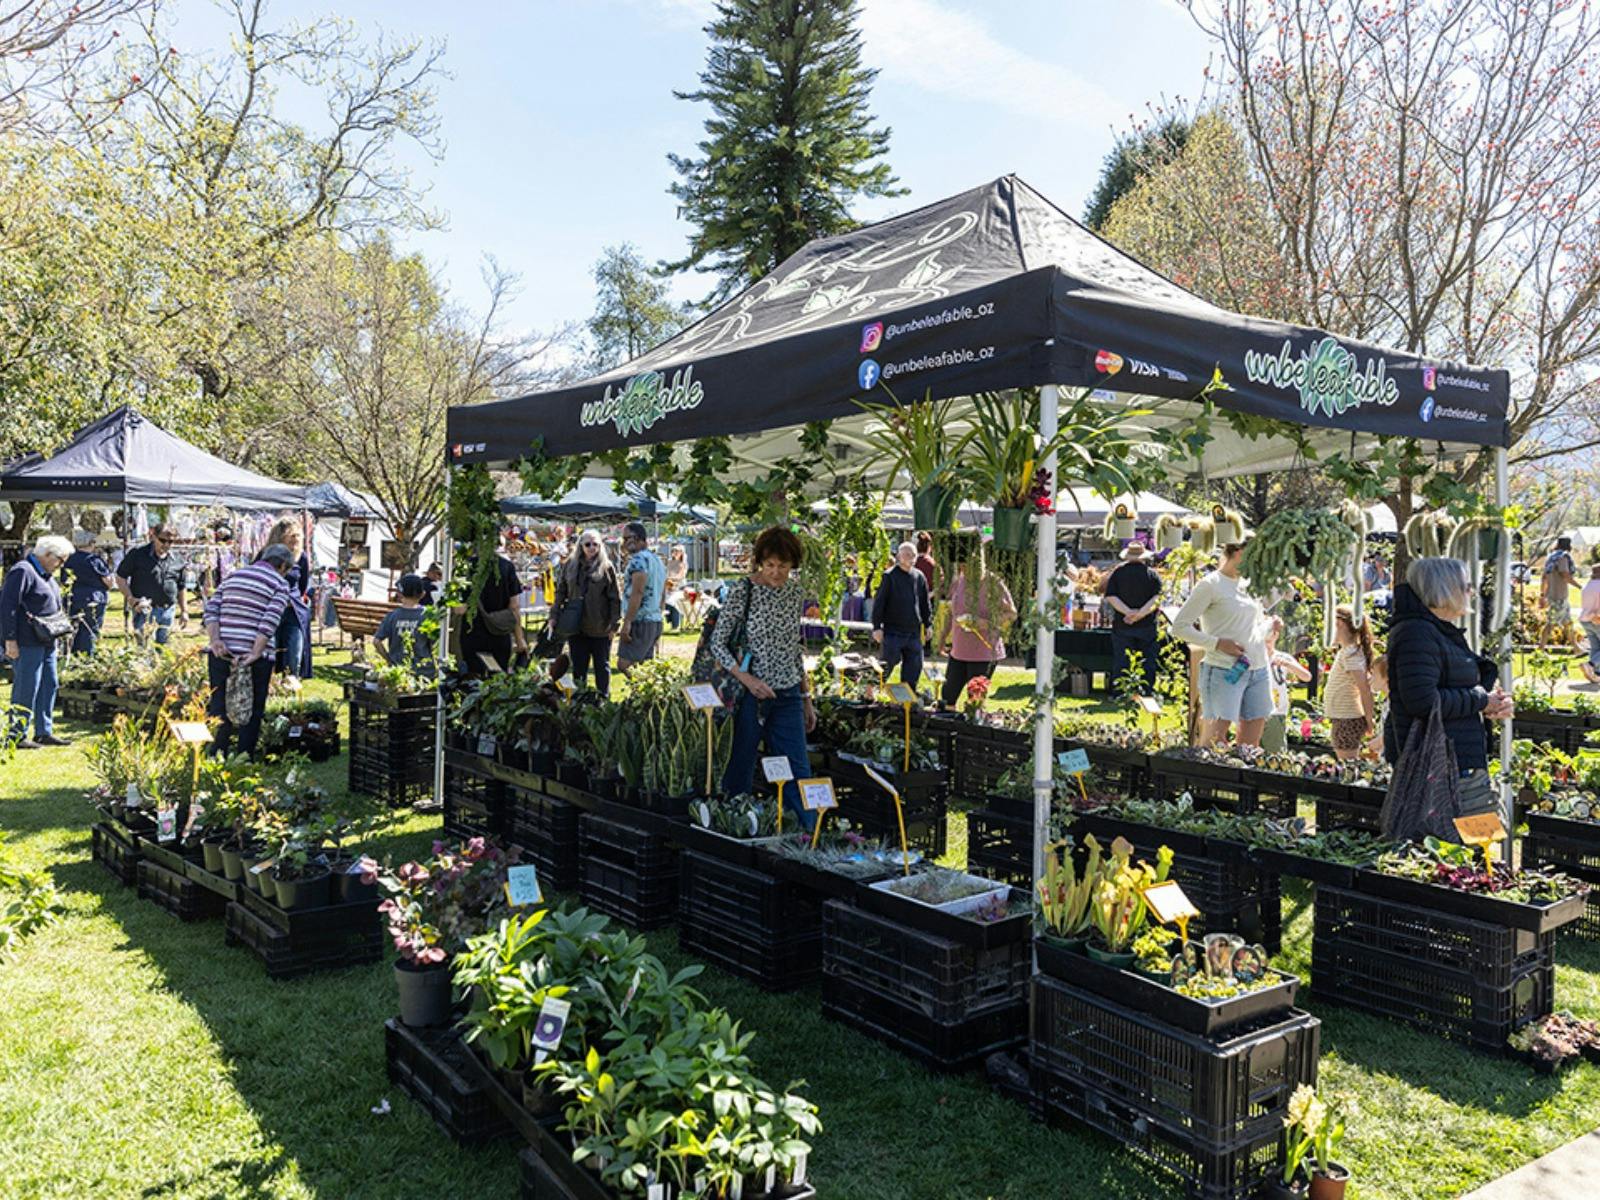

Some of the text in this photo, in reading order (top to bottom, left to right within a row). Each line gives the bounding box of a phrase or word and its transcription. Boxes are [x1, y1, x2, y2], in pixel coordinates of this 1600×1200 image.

[884, 302, 995, 340] @unbeleafable_oz
[881, 346, 995, 379] @unbeleafable_oz
[1127, 357, 1160, 378] VISA
[1245, 339, 1400, 407] unbeleafable
[580, 364, 705, 428] unbeleafable
